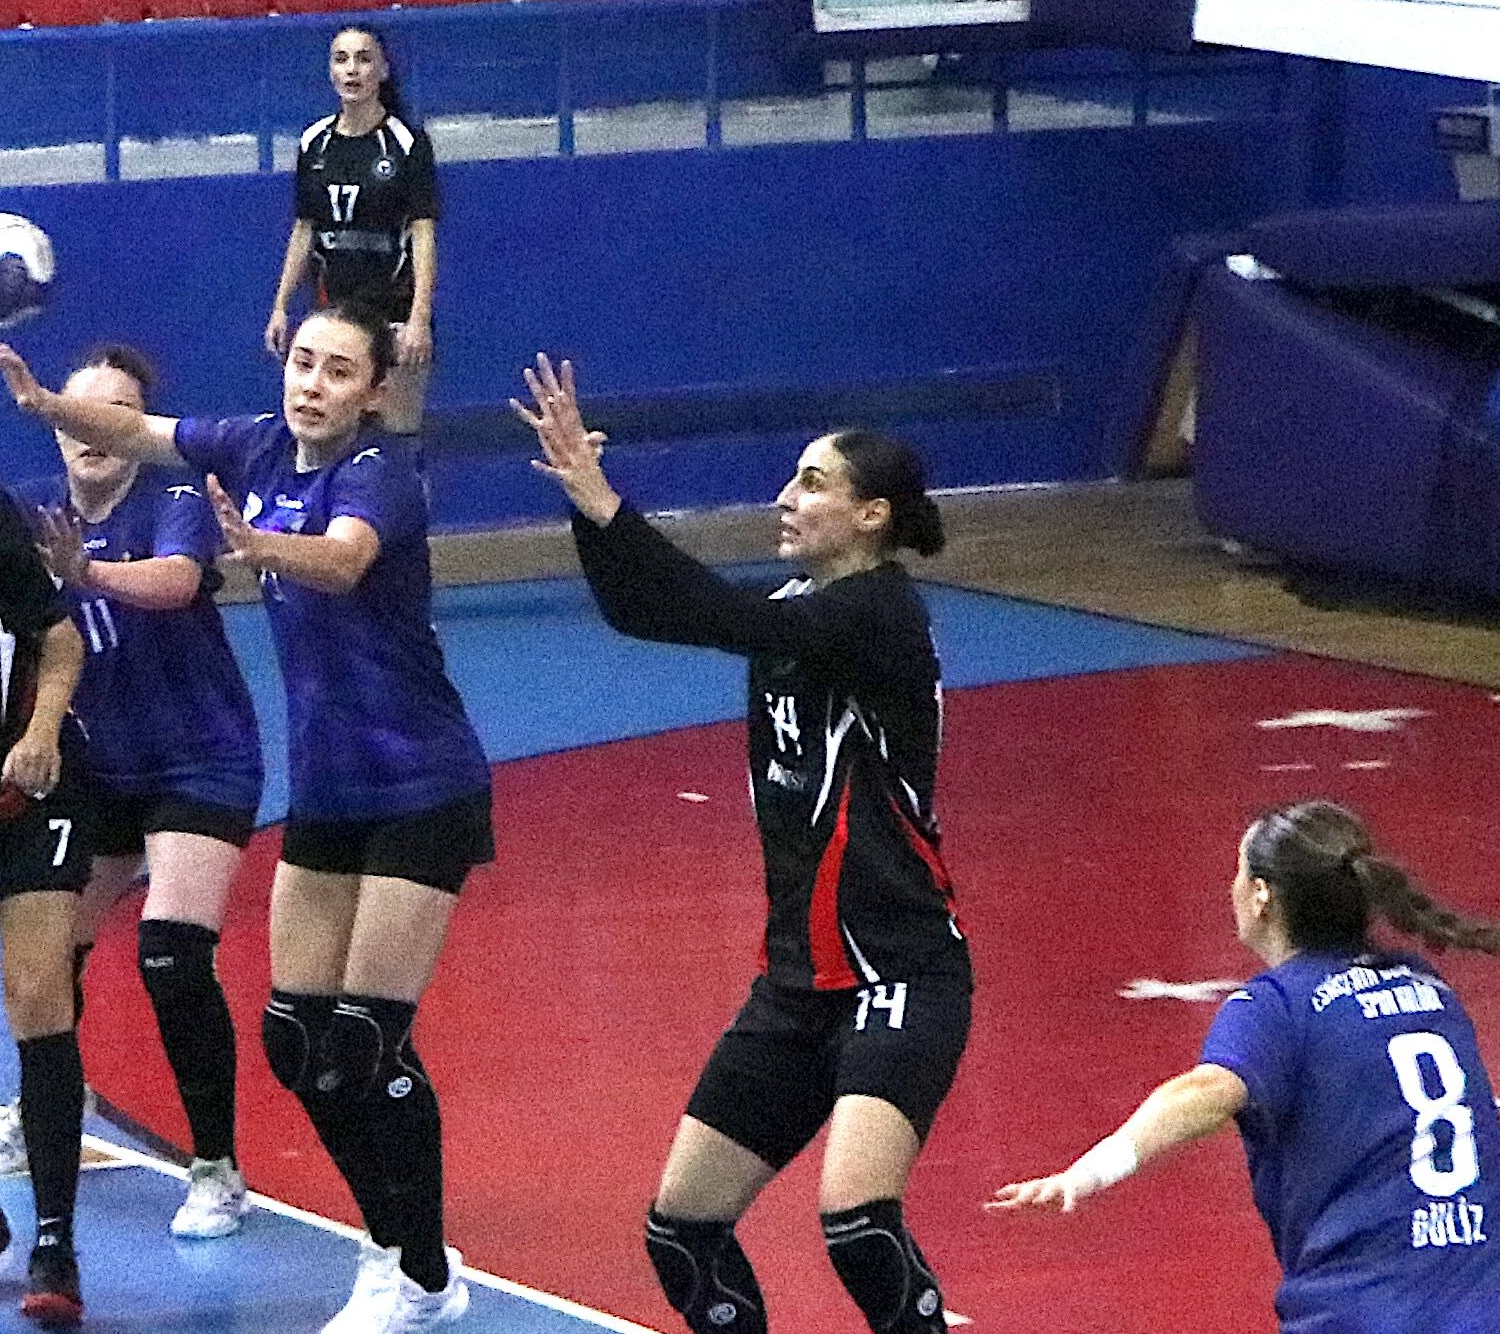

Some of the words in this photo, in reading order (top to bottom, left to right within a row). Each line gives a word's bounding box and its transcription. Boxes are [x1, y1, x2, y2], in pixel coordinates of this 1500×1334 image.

[327, 183, 361, 223] 17
[80, 598, 119, 654] 11
[48, 818, 73, 867] 7
[855, 981, 908, 1032] 14
[1387, 1030, 1481, 1198] 8
